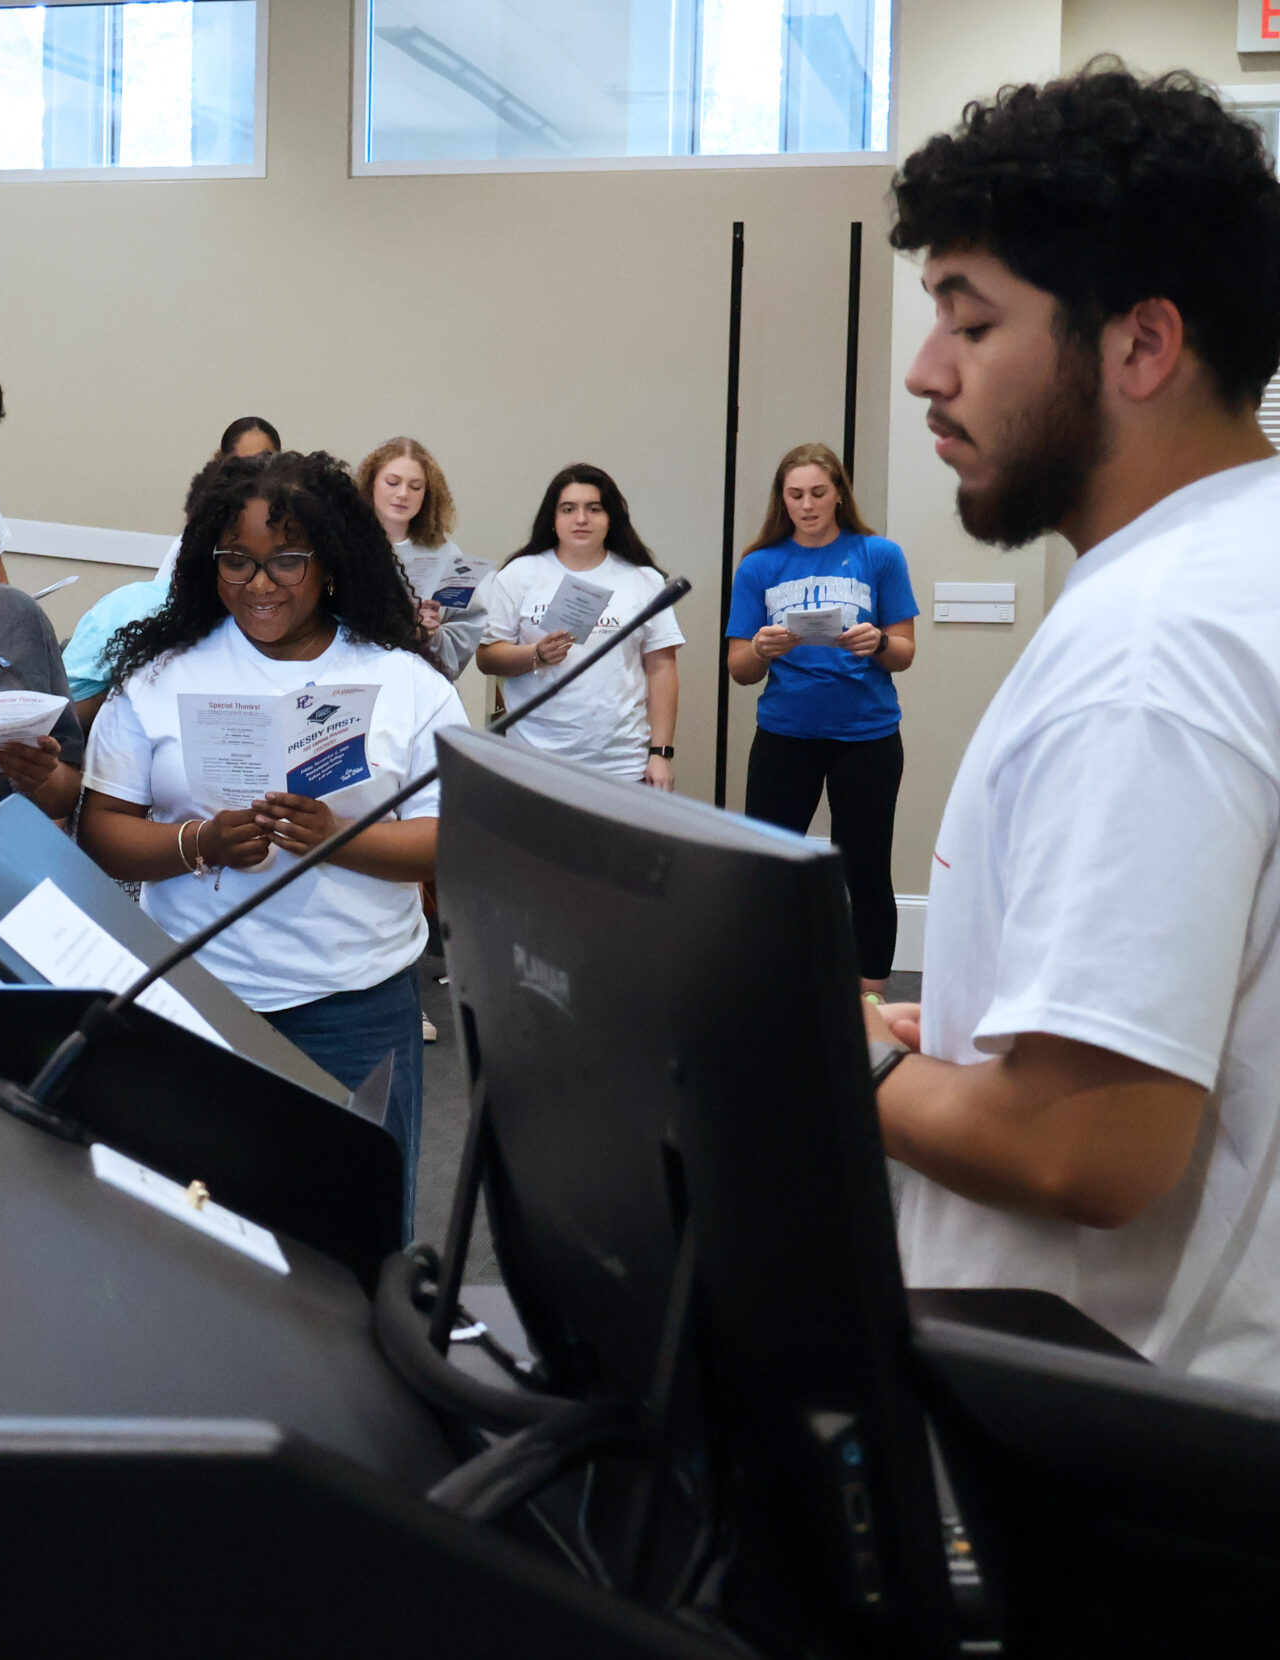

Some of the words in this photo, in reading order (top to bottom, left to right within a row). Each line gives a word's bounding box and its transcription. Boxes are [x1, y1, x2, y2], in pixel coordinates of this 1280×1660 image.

[208, 701, 233, 710] Special
[287, 729, 325, 755] PRESBY
[326, 716, 362, 733] FIRST+
